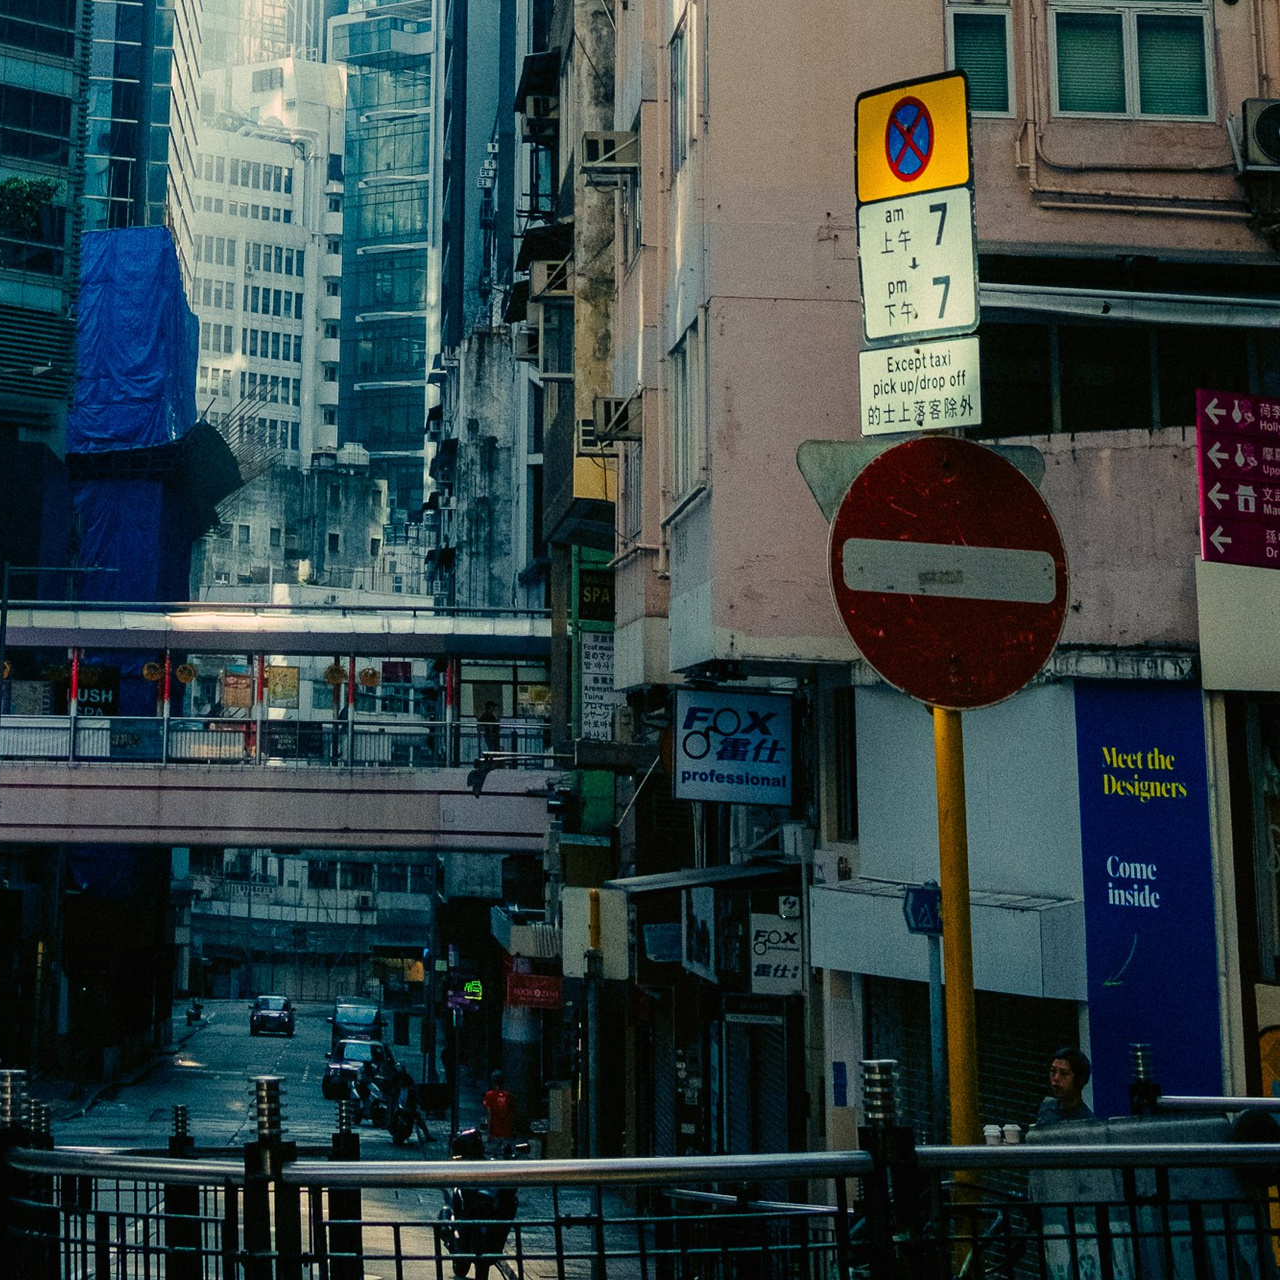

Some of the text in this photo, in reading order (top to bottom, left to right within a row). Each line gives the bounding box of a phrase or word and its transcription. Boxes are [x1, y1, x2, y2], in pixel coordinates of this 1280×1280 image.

[885, 202, 948, 246] am 7
[881, 228, 912, 255] 上午
[888, 275, 951, 319] pm 7
[884, 301, 915, 327] 下午
[887, 349, 952, 374] Except taxi
[873, 370, 966, 399] pick up/drop off
[867, 394, 974, 427] 的士上落客除外
[1265, 546, 1279, 559] Dr
[582, 586, 610, 603] SPA
[683, 707, 778, 737] FOX
[1101, 746, 1176, 771] Meet the
[681, 769, 788, 788] professional
[1103, 773, 1188, 804] Designers
[1105, 854, 1158, 881] Come
[1107, 881, 1161, 909] inside
[754, 929, 798, 945] FOX
